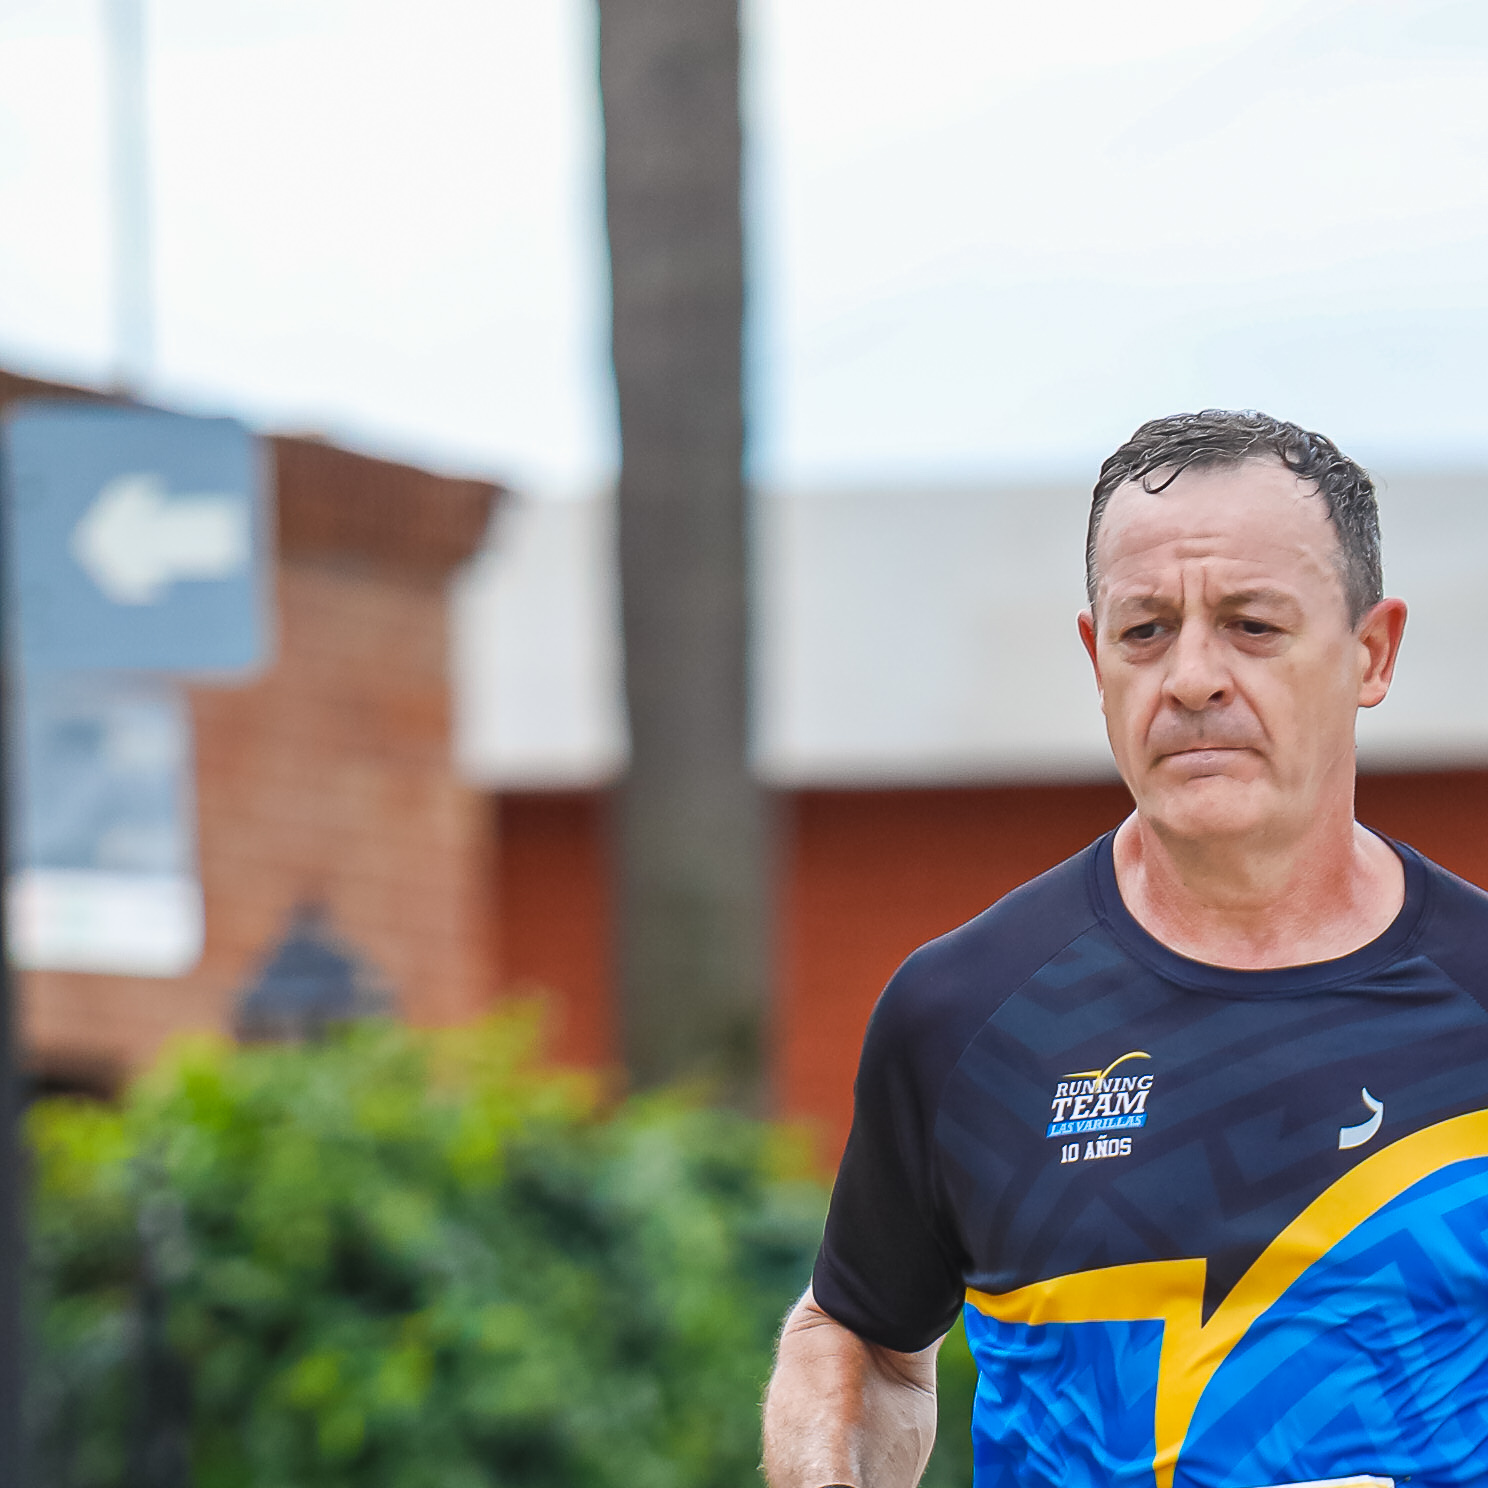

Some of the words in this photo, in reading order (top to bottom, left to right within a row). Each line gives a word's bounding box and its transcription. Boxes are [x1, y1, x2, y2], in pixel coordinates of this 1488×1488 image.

[1055, 1074, 1154, 1098] RUNNING
[1051, 1090, 1150, 1122] TEAM
[1049, 1122, 1073, 1136] LAS
[1077, 1115, 1144, 1131] VARILLAS
[1060, 1143, 1080, 1163] 10
[1083, 1134, 1132, 1160] AÑOS
